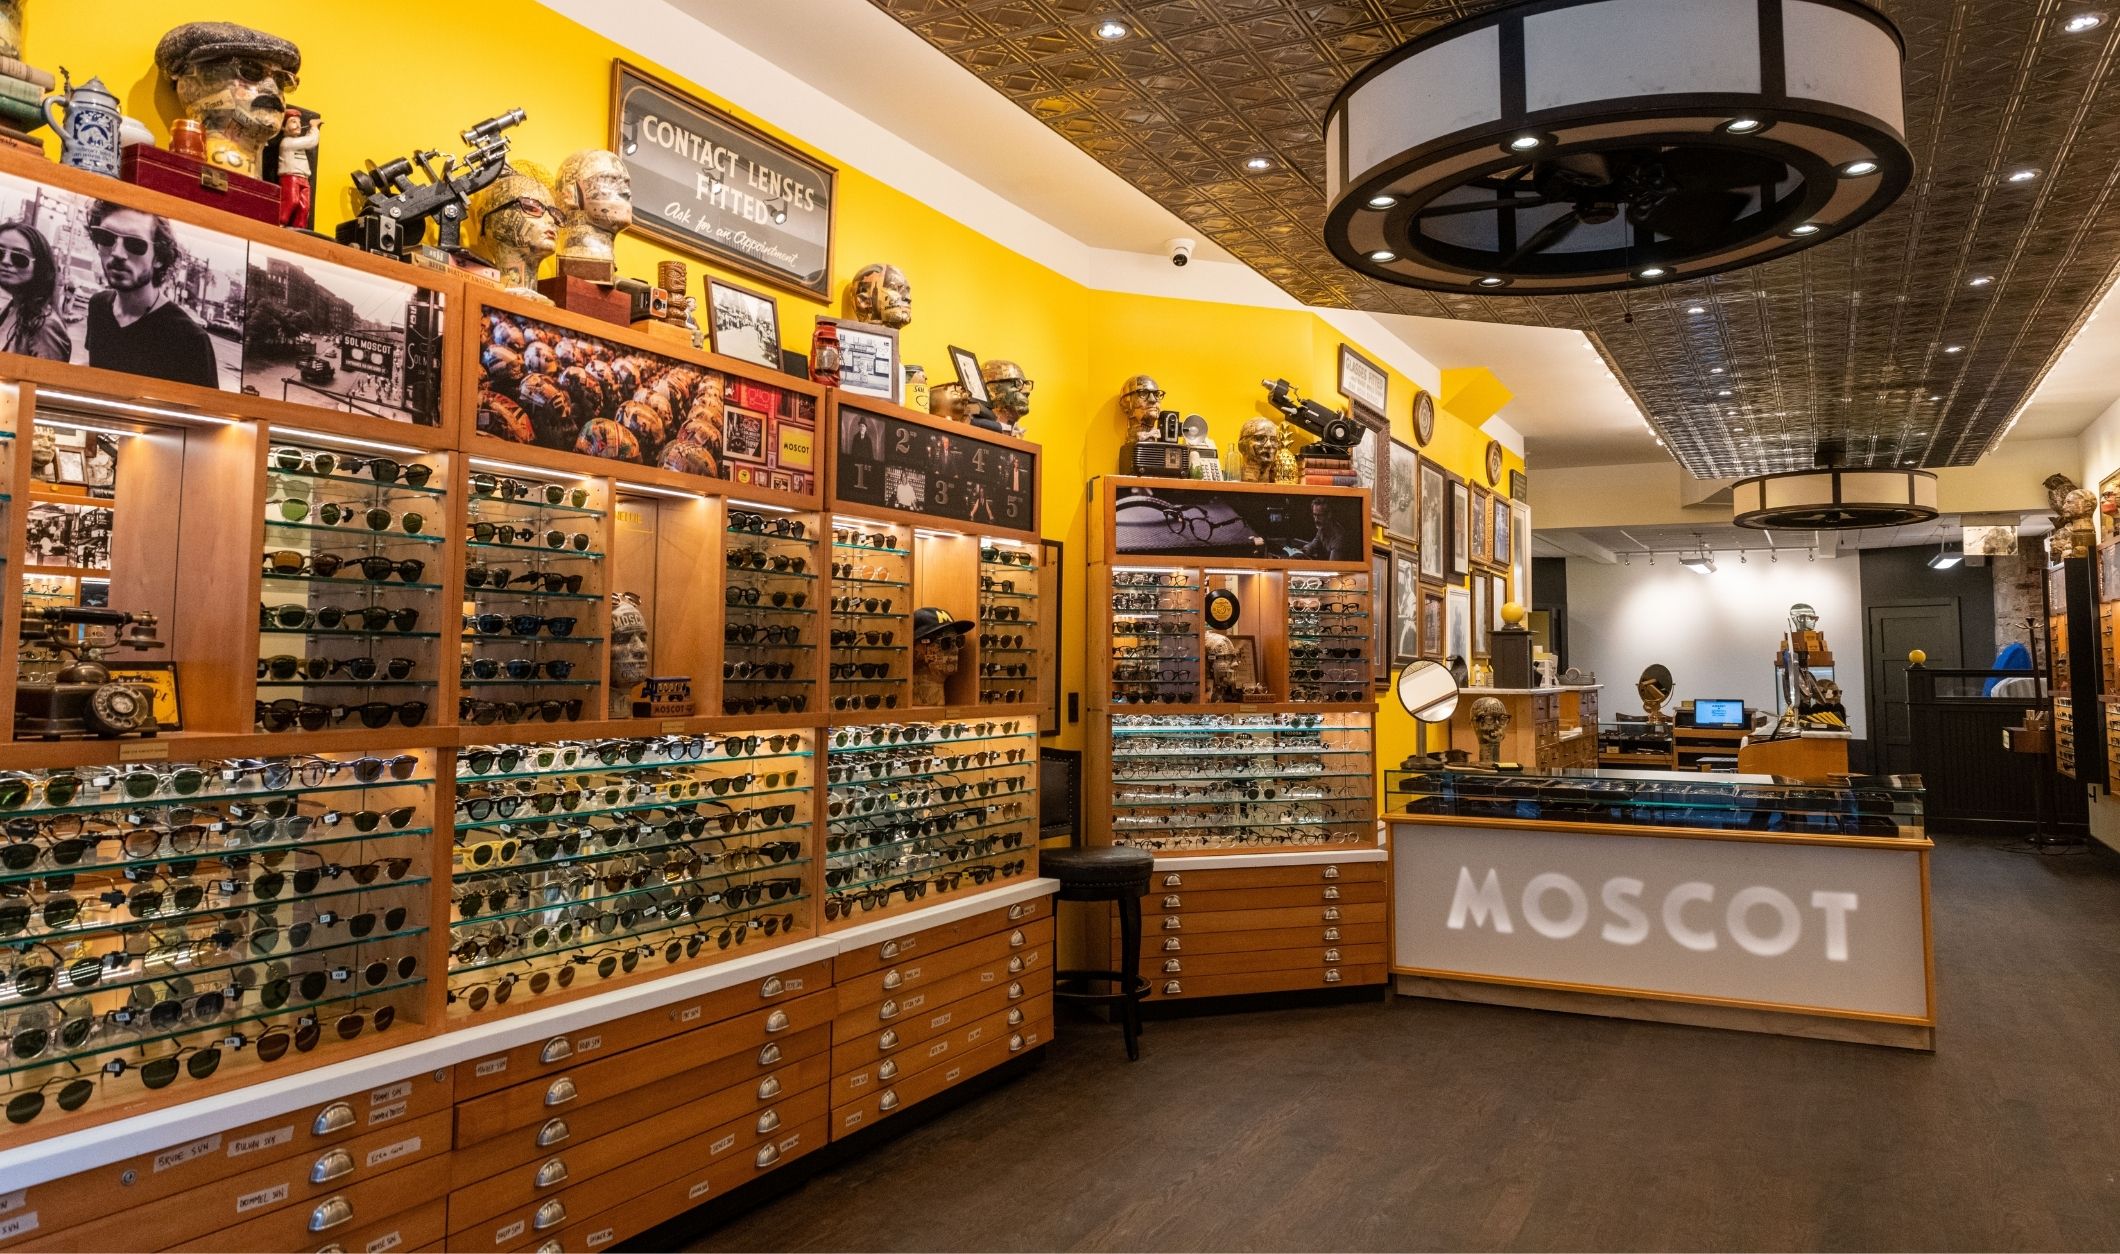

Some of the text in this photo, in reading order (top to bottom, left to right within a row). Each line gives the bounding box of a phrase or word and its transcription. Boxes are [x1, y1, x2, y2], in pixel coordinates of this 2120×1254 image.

[642, 115, 815, 212] CONTACT LENSES
[695, 172, 769, 226] FITTED
[664, 202, 799, 268] Ask for an Appointment
[344, 336, 392, 355] SOL MOSCOT
[1345, 356, 1367, 381] GLASSES
[783, 442, 810, 454] MOSCOT
[654, 703, 685, 714] MOSCOT
[1445, 865, 1860, 962] MOSCOT
